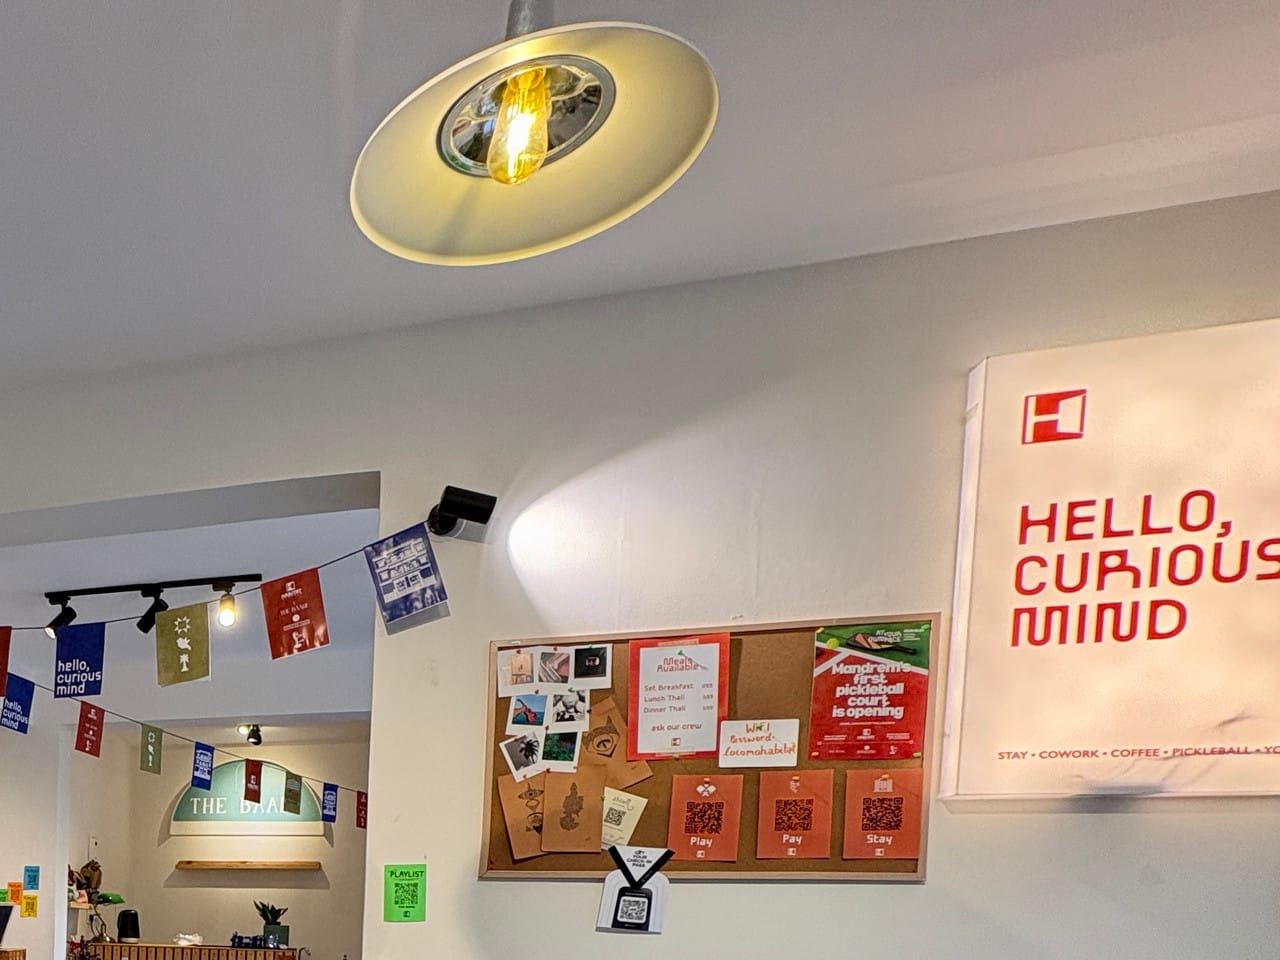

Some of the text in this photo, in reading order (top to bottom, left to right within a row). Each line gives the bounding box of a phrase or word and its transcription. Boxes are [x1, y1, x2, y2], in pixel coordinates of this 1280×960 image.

[1018, 489, 1233, 545] HELLO,
[1014, 537, 1280, 596] CURIOUS
[1011, 599, 1188, 647] MIND
[58, 659, 90, 673] hello,
[663, 657, 693, 665] Meals
[57, 671, 102, 684] curious
[853, 673, 888, 684] first
[56, 683, 85, 696] mind
[658, 683, 694, 691] Breakfast
[835, 683, 905, 698] pickleball
[4, 699, 23, 714] hello,
[847, 695, 890, 707] court
[2, 708, 28, 724] curious
[832, 705, 905, 719] is opening
[1, 716, 19, 729] mind
[651, 723, 666, 732] ask
[997, 751, 1028, 760] STAY
[1038, 750, 1100, 759] COWORK
[1110, 748, 1160, 758] COFFEE
[1172, 746, 1249, 757] PICKLEBALL
[190, 797, 227, 814] THE
[689, 837, 713, 847] Play
[782, 834, 803, 845] Pay
[866, 834, 893, 845] Stay
[389, 870, 425, 878] PLAYLIST
